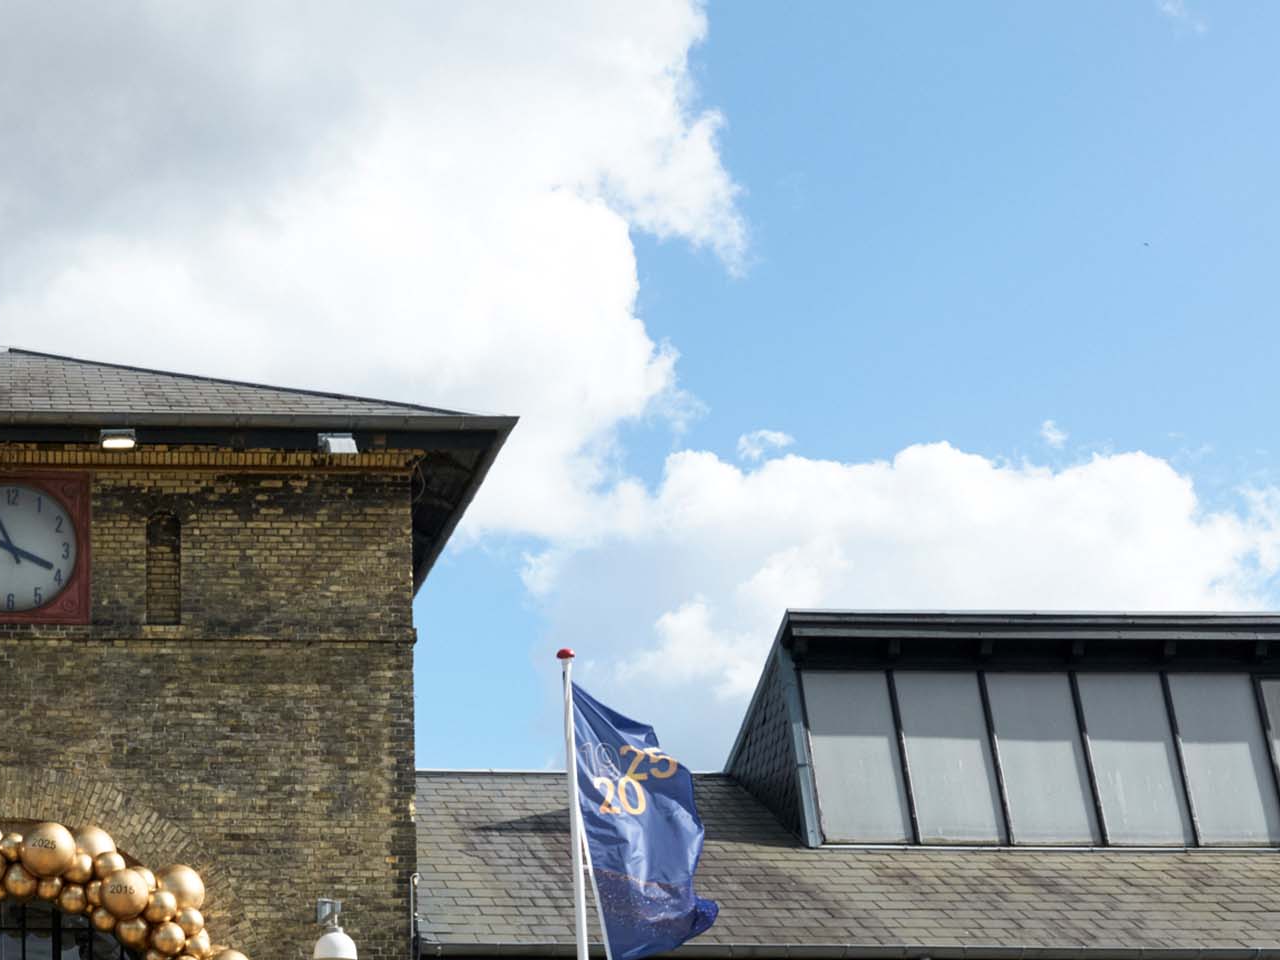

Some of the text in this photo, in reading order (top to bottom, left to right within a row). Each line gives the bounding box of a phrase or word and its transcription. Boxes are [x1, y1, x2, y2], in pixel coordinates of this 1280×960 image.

[6, 488, 19, 506] 12
[36, 496, 42, 513] 1
[55, 515, 64, 533] 2
[62, 542, 70, 560] 3
[53, 568, 63, 586] 4
[6, 593, 15, 610] 6
[34, 587, 42, 605] 5
[593, 775, 647, 815] 20
[32, 837, 57, 850] 2025
[110, 884, 136, 895] 2015
